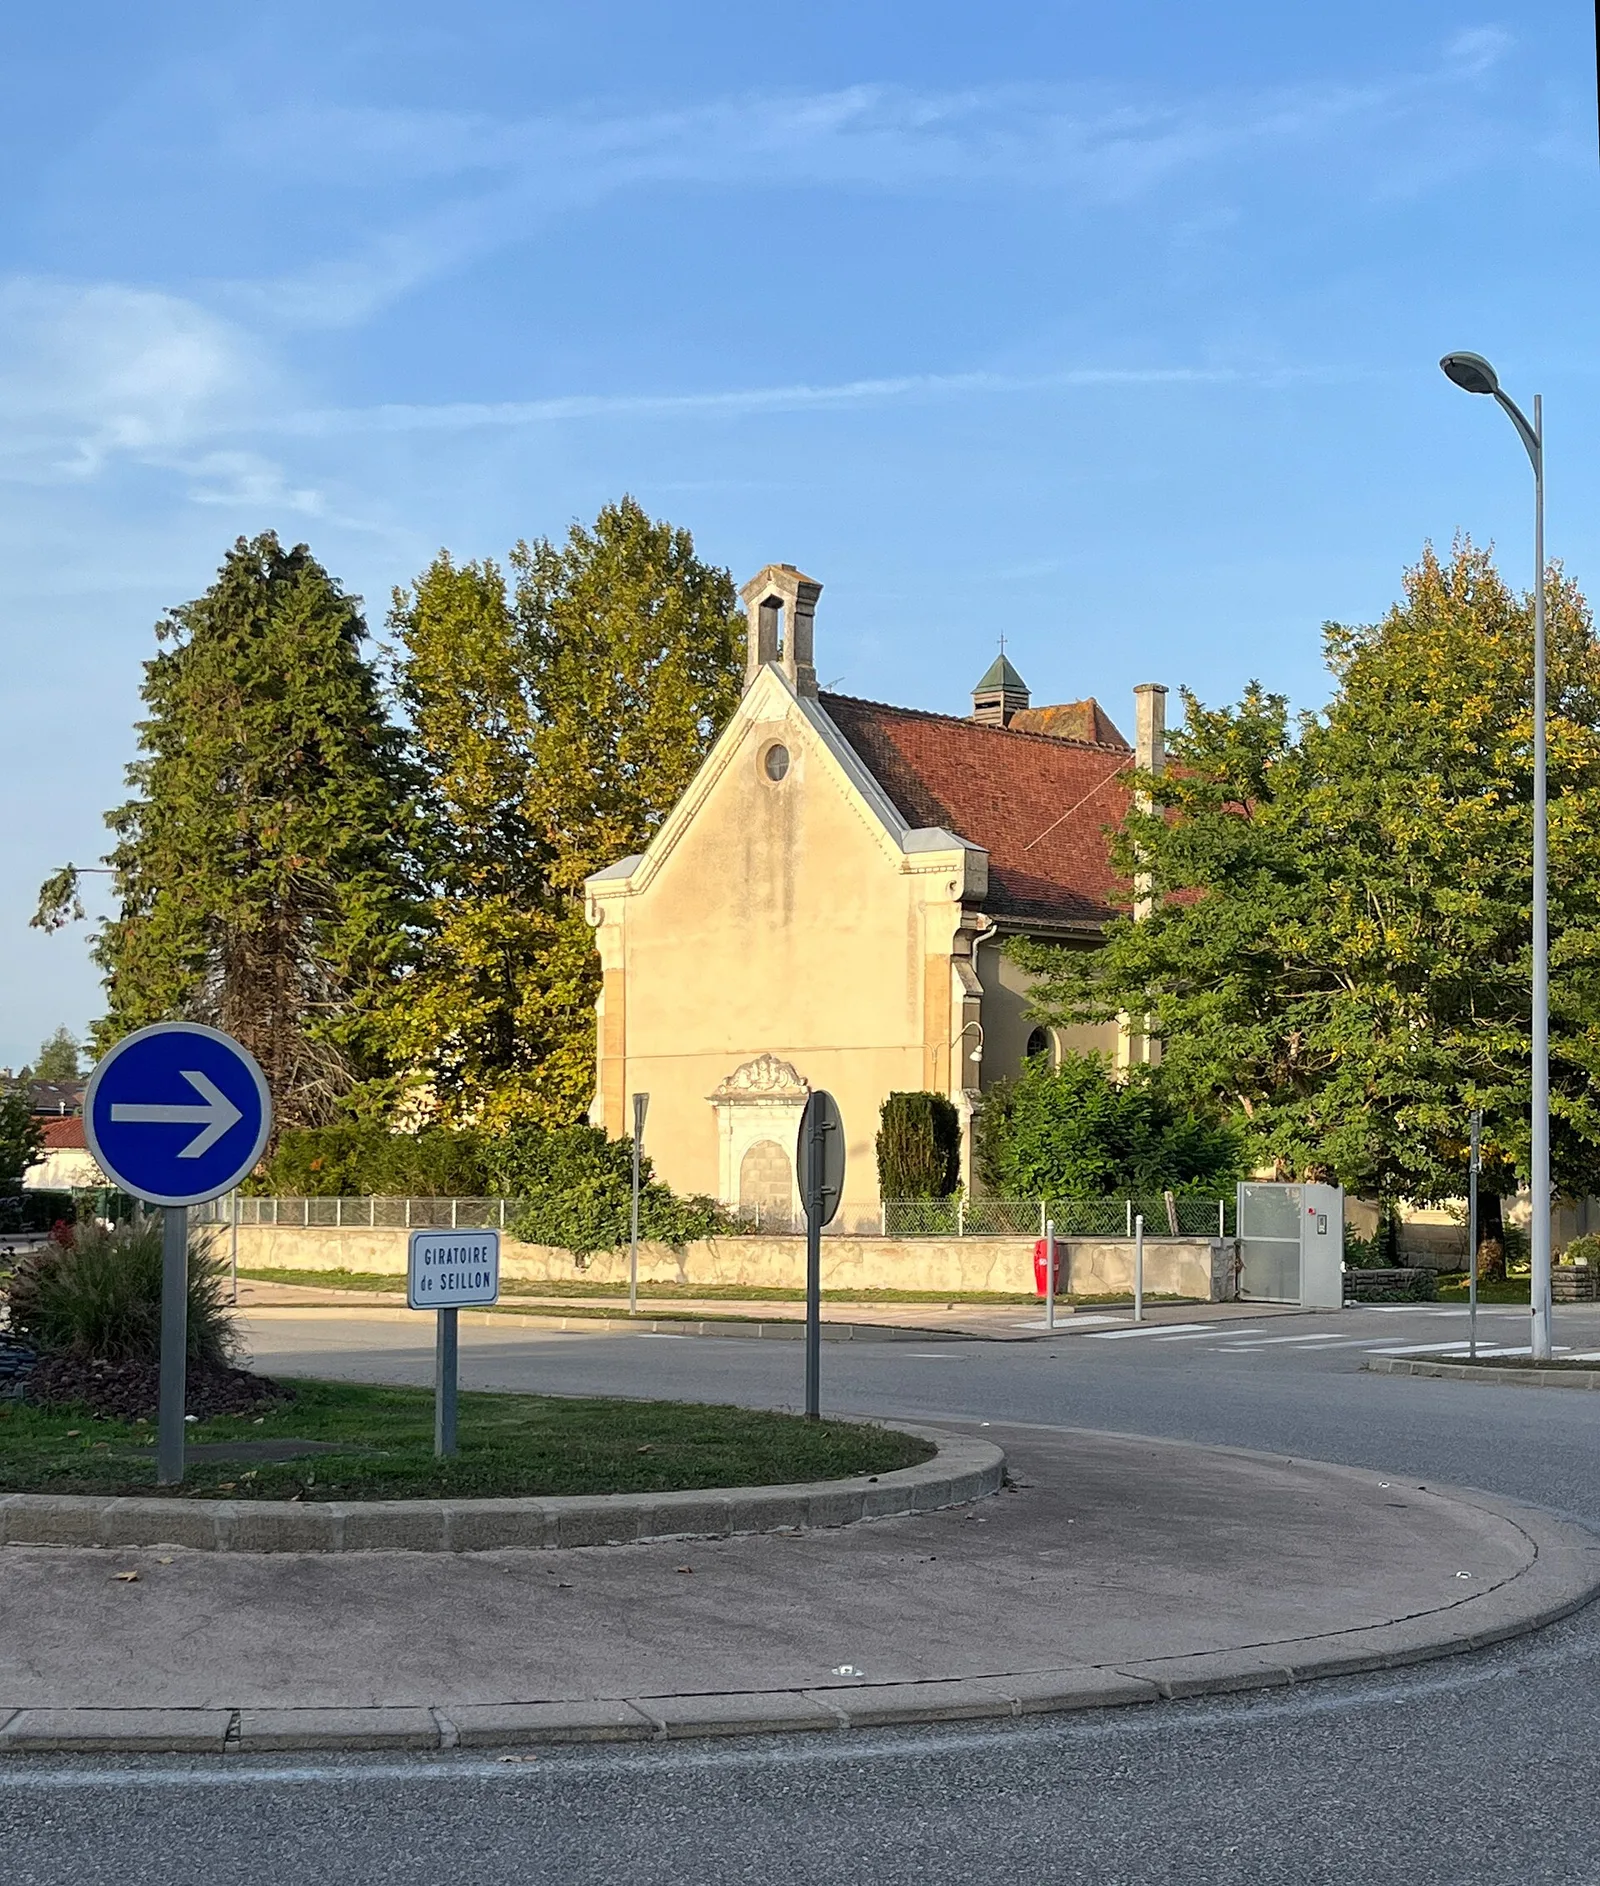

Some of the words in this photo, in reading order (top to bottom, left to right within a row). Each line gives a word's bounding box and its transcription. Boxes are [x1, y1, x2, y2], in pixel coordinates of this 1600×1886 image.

[424, 1246, 488, 1265] GIRATOIRE
[420, 1275, 433, 1291] de
[440, 1271, 490, 1290] SEILLON
